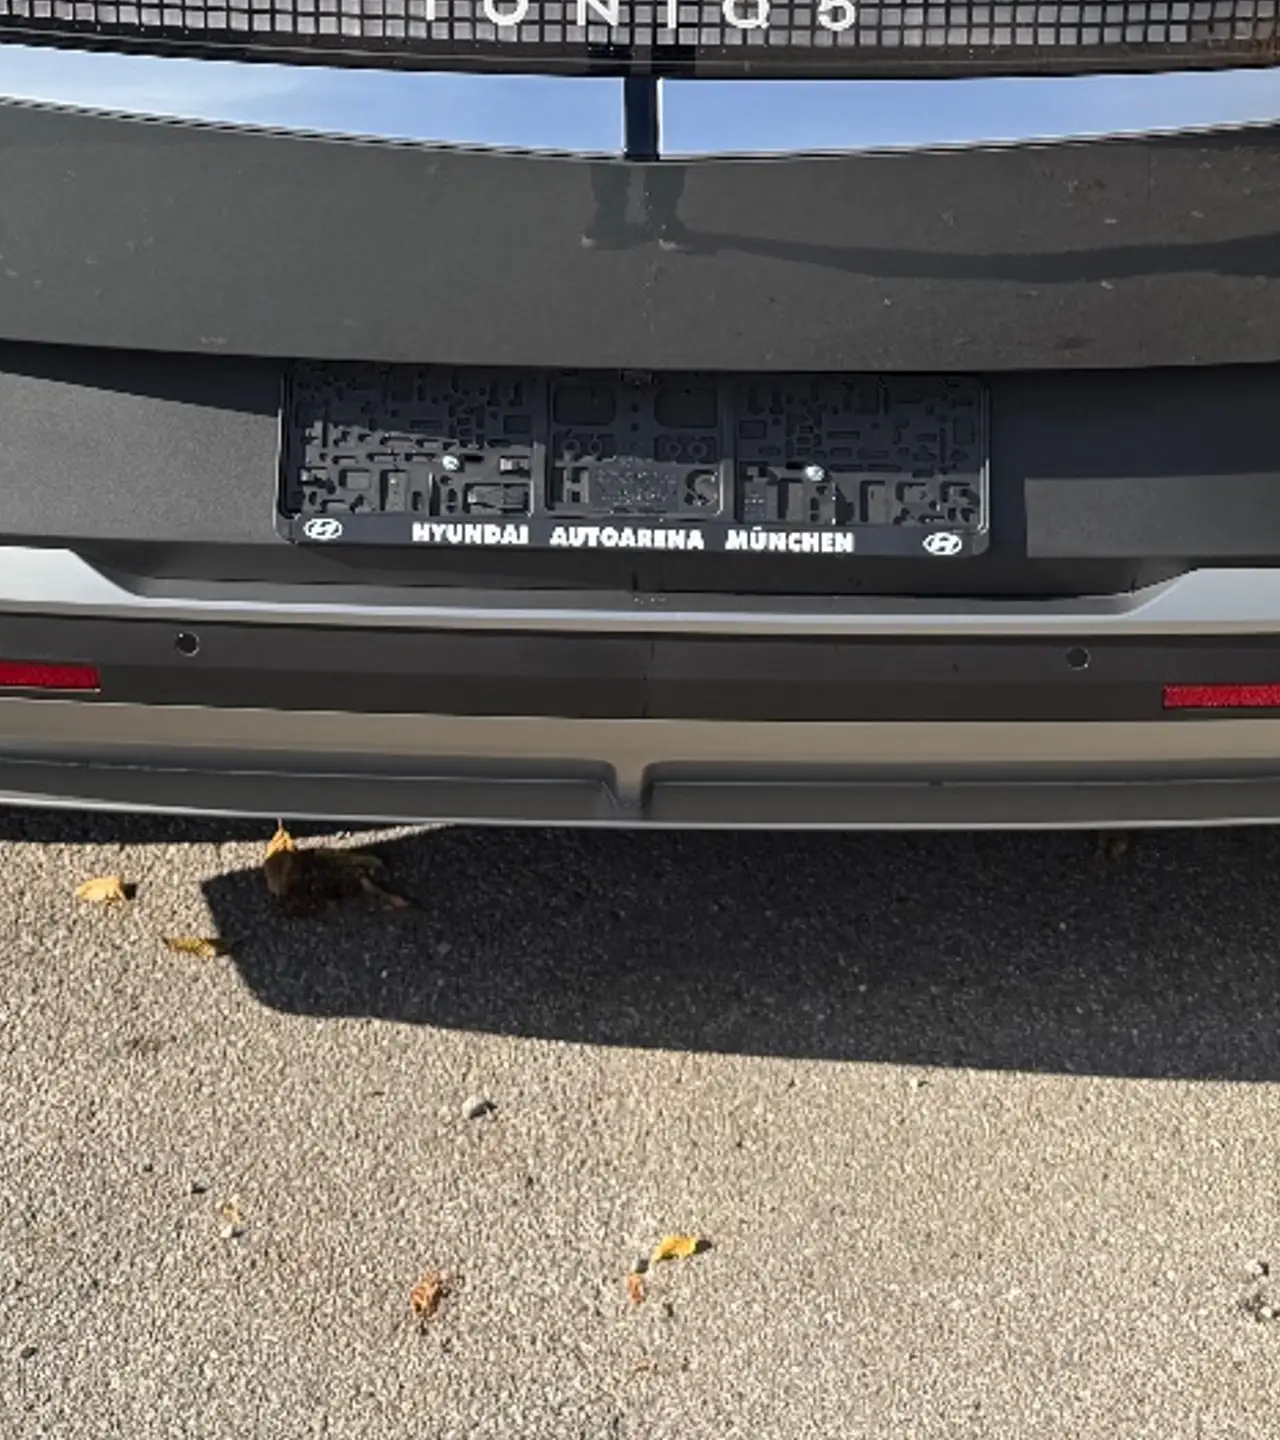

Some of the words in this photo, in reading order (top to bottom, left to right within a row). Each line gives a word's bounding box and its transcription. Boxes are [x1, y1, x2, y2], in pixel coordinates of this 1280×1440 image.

[411, 523, 530, 546] HYUNDAI
[549, 526, 706, 550] AUTOARENA
[725, 526, 855, 553] MÜNCHEN
